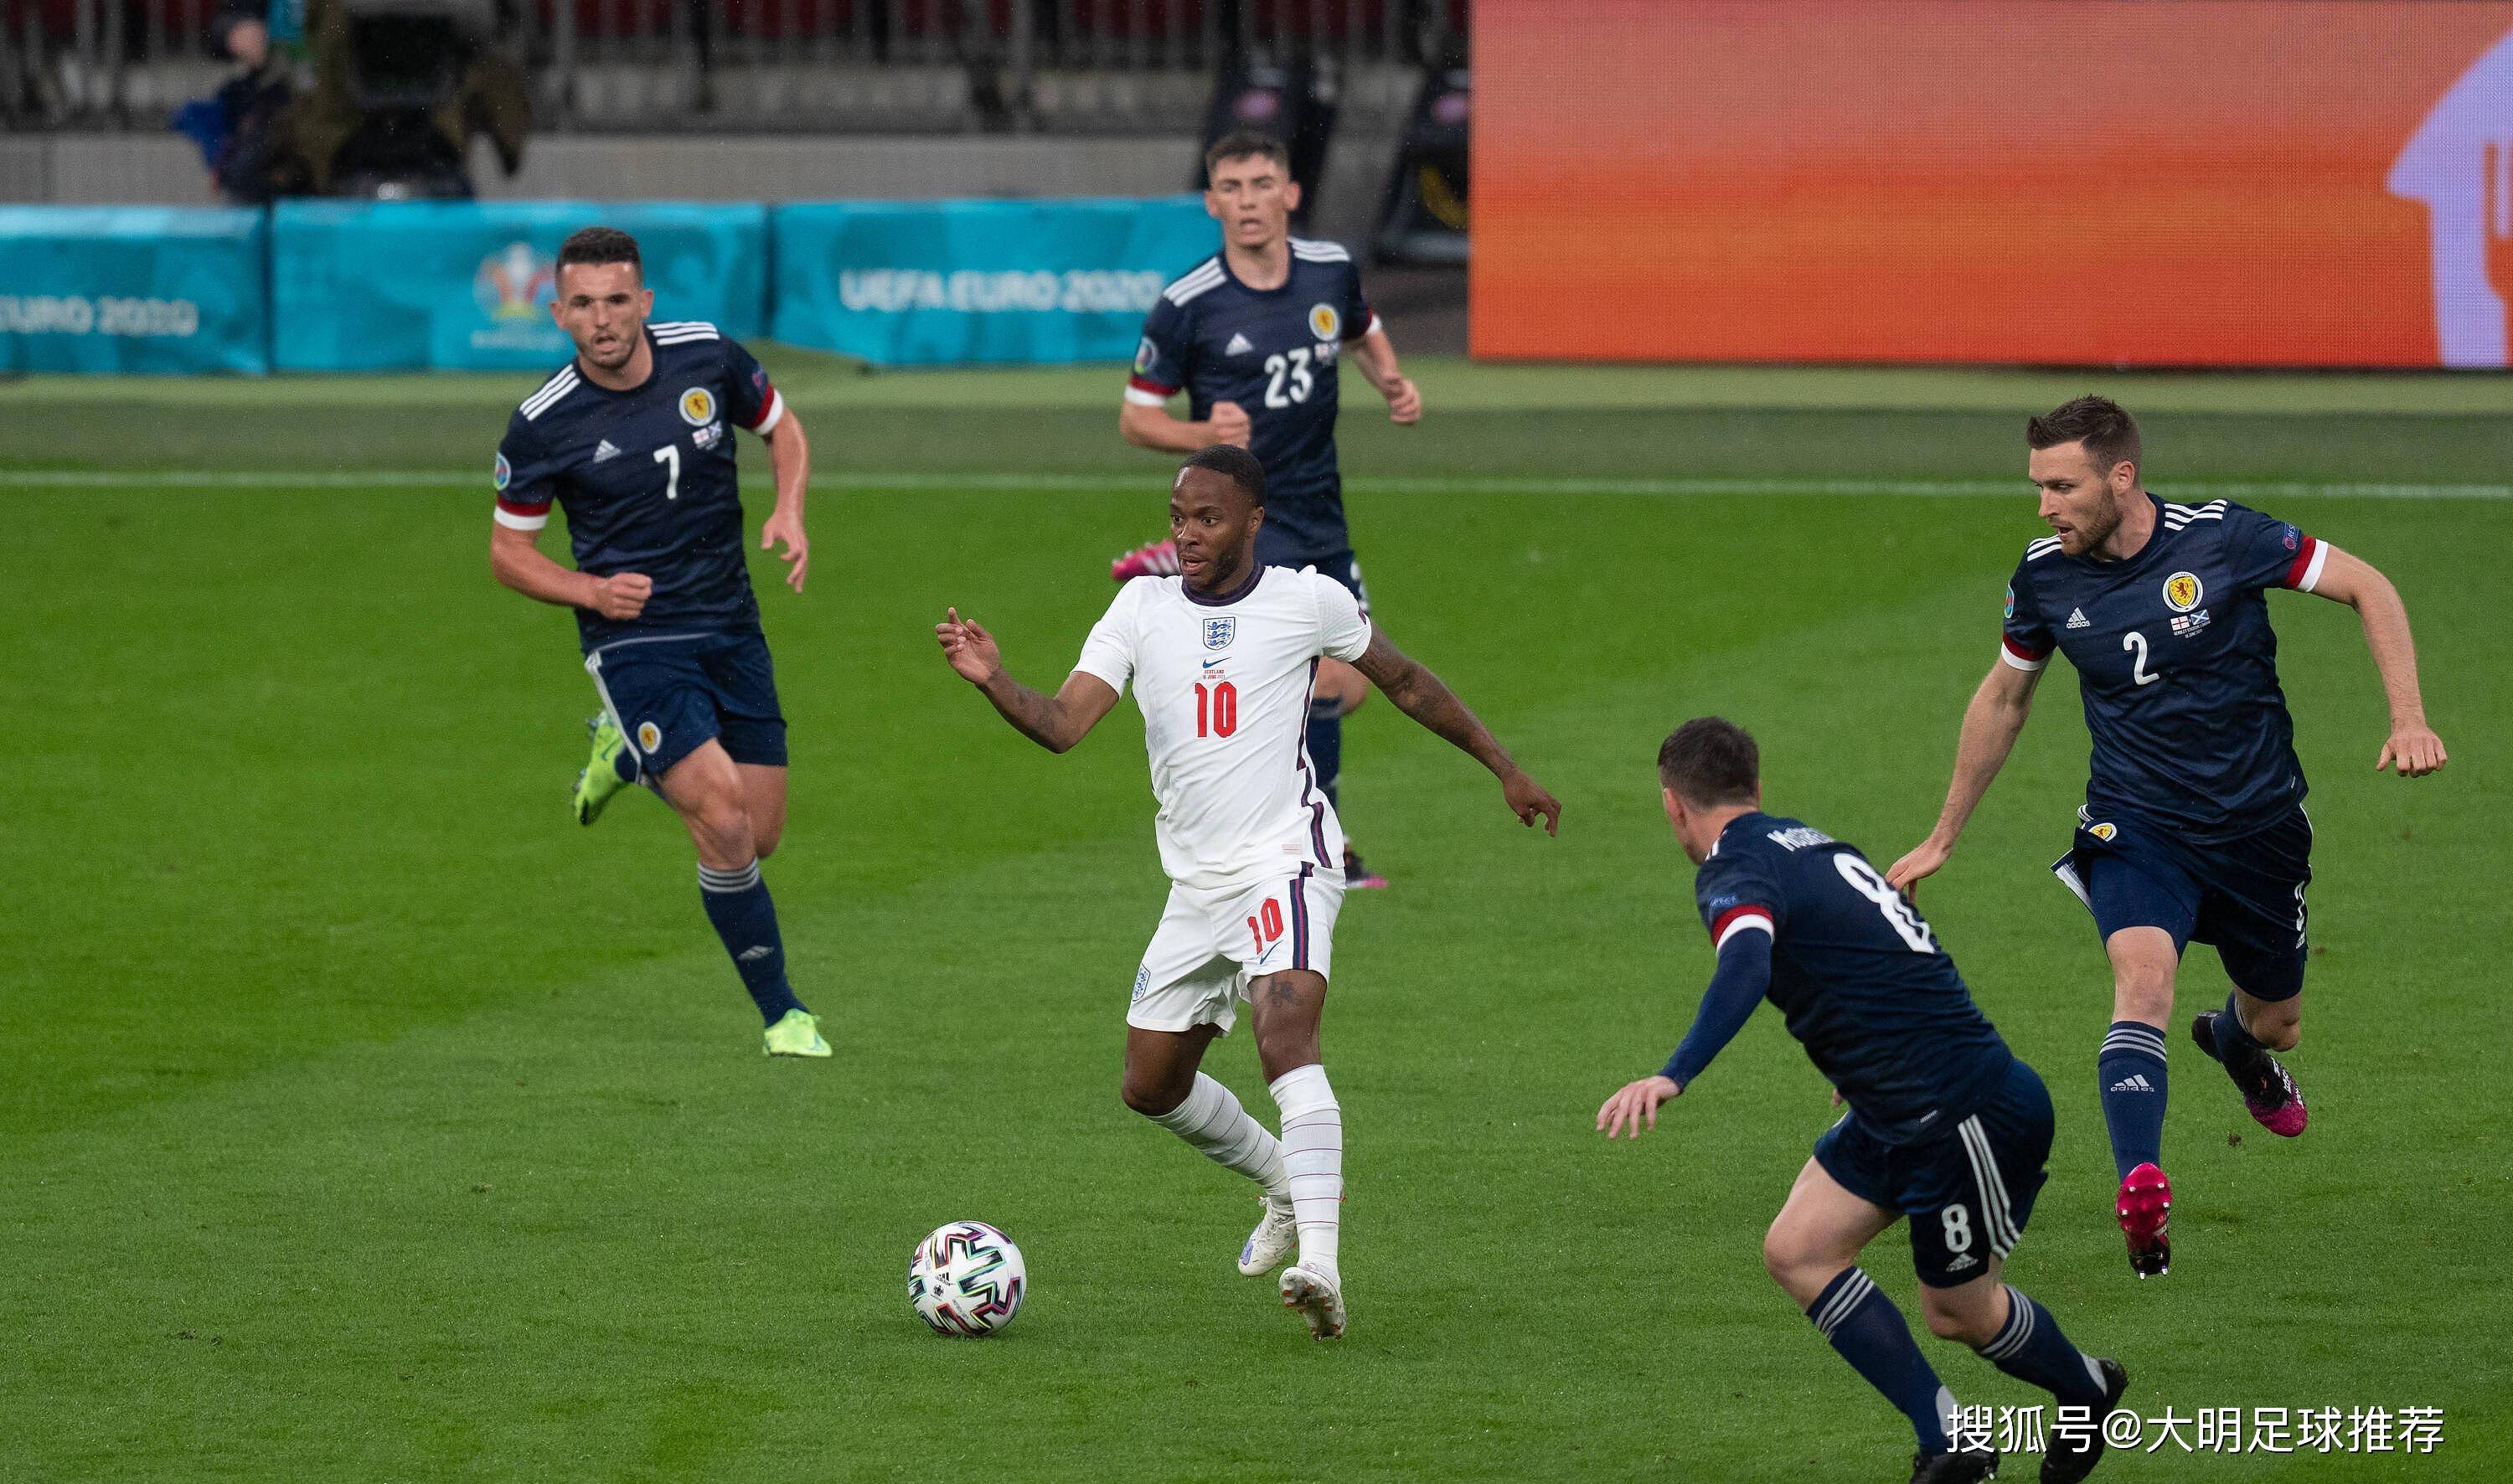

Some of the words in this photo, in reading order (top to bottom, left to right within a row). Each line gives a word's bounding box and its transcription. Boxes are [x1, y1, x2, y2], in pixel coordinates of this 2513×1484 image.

[839, 269, 944, 312] UEFA
[949, 270, 1057, 313] EURO
[1061, 270, 1164, 313] 2020
[1264, 347, 1314, 409] 23
[653, 445, 680, 499] 7
[2123, 631, 2160, 685] 2
[1195, 681, 1237, 738] 10
[1247, 899, 1284, 955] 10
[1833, 853, 1936, 954] 8
[1942, 1203, 1972, 1253] 8
